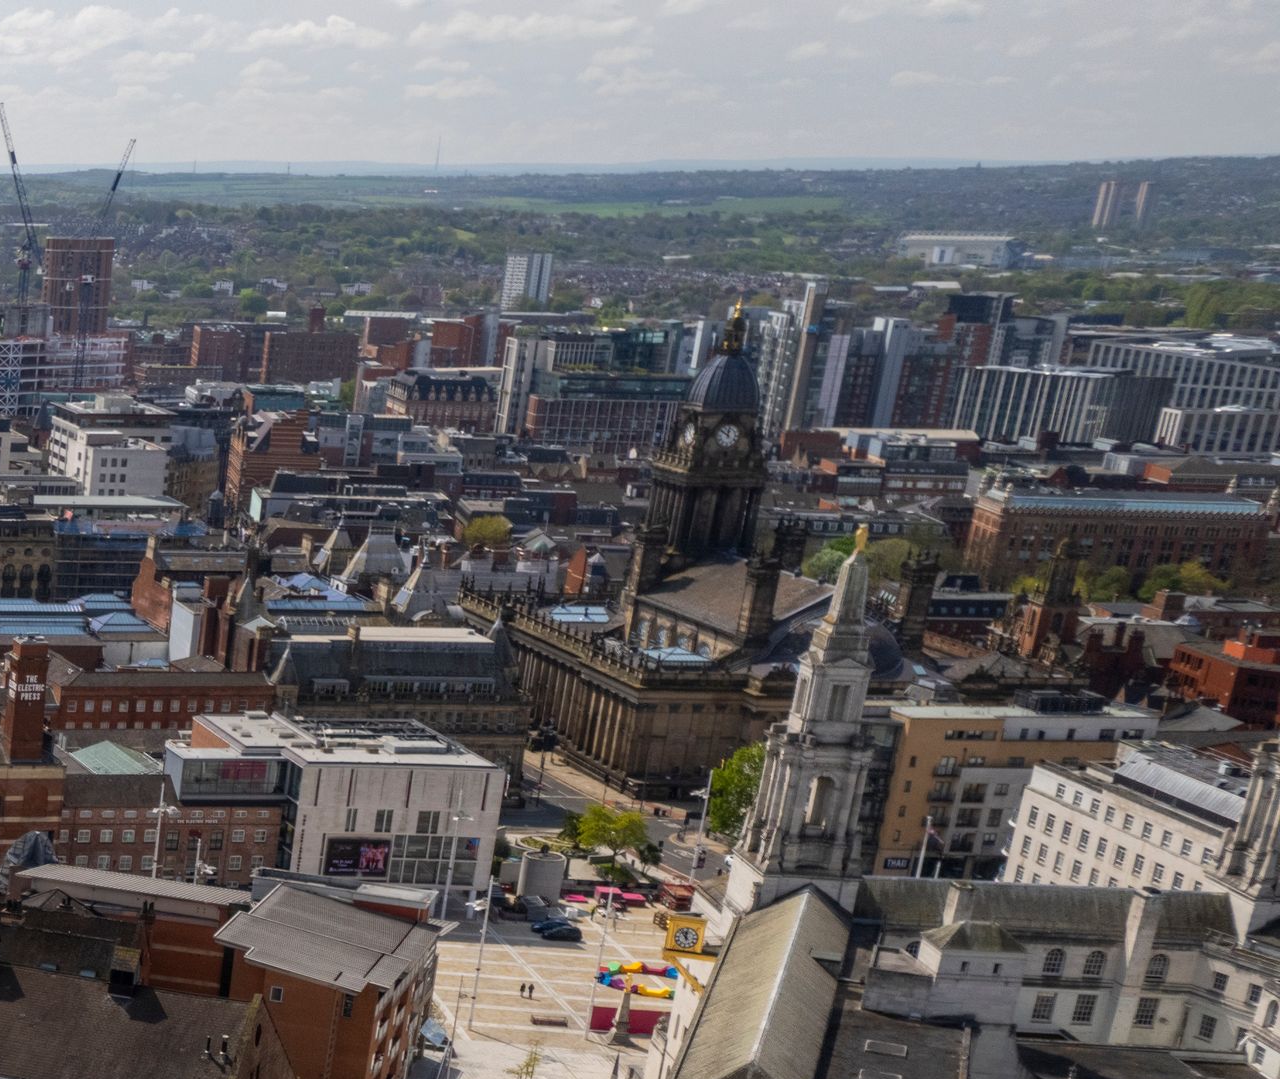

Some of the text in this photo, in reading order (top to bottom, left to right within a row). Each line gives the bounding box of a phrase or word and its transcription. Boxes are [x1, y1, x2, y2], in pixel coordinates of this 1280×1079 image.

[26, 675, 38, 683] THE
[18, 684, 45, 692] ELECTRIC
[20, 692, 41, 701] PRESS
